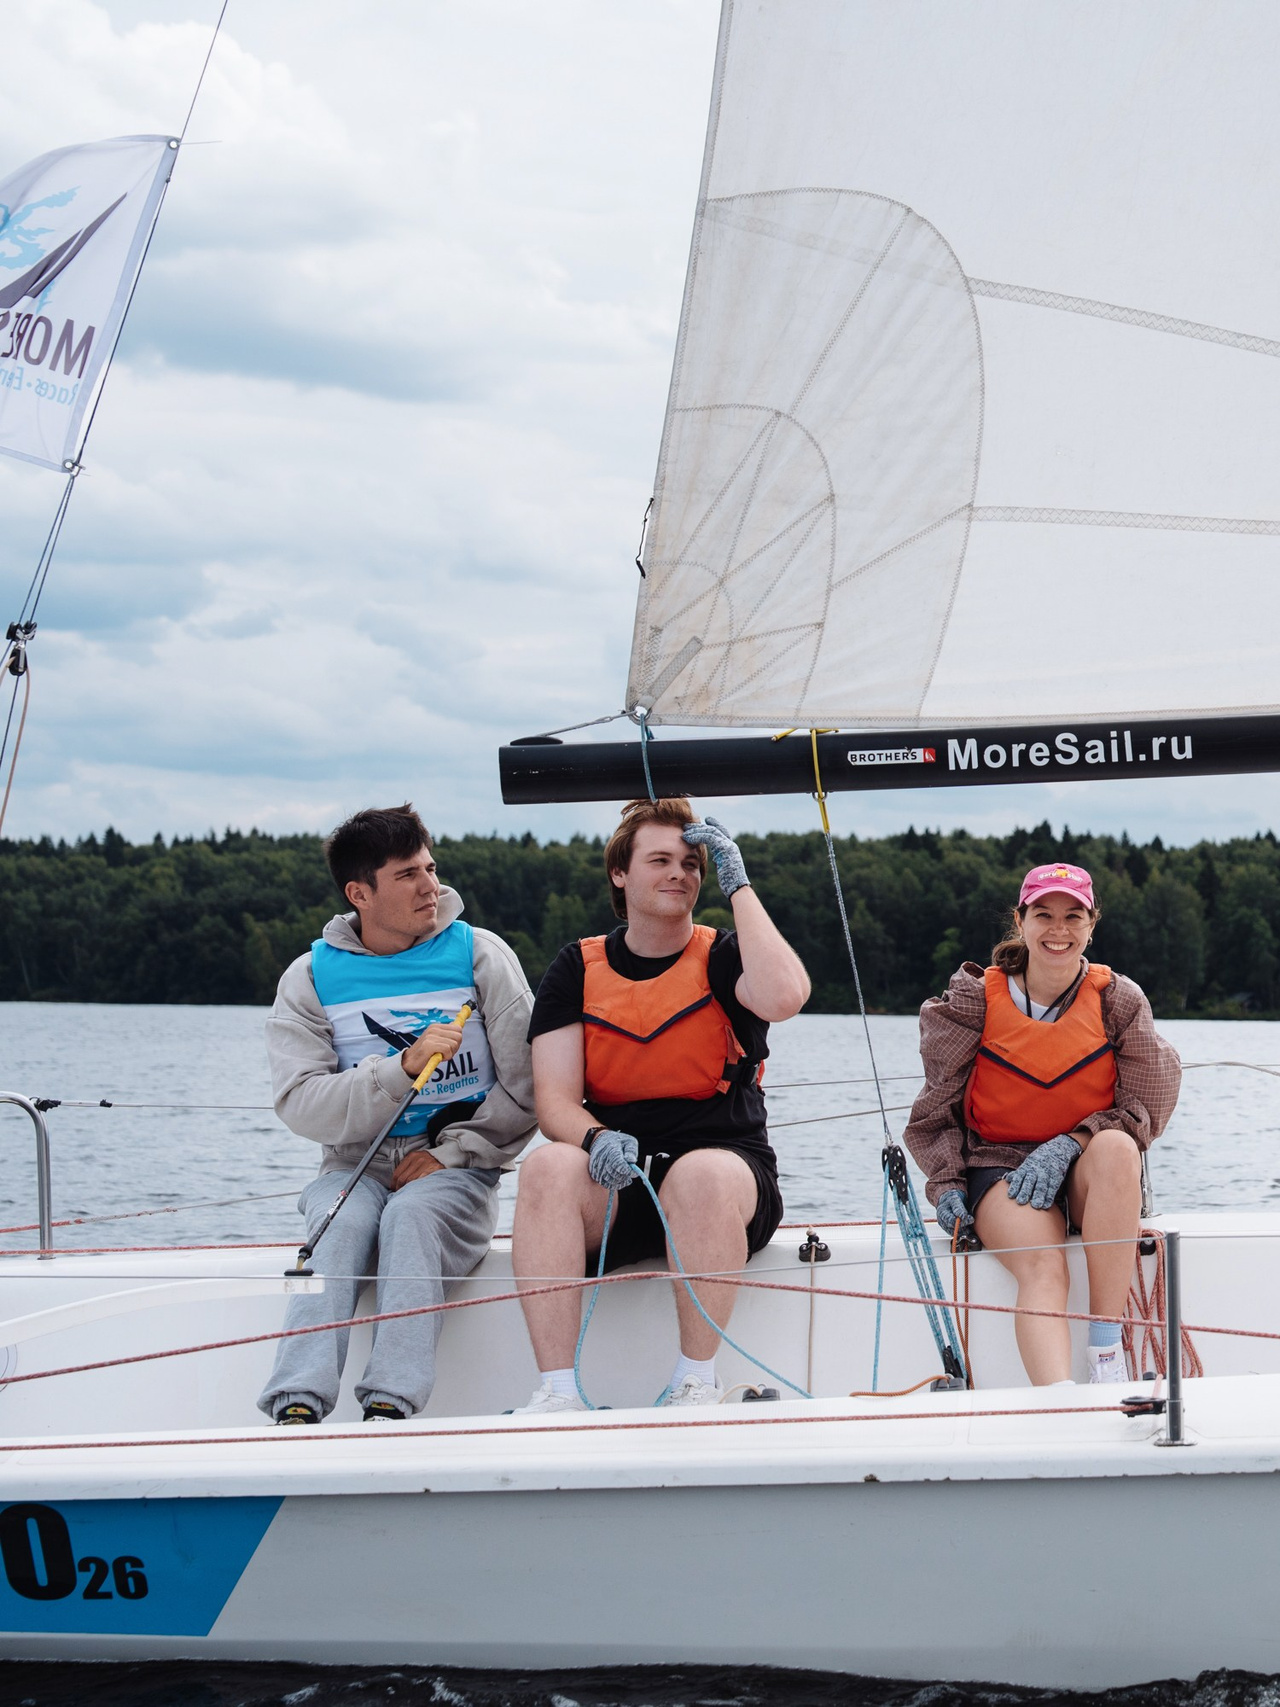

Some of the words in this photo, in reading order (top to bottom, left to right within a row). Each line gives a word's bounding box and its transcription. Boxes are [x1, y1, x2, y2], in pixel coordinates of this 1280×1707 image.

[850, 751, 918, 763] BROTHERS
[947, 730, 1193, 771] MoreSail.ru
[436, 1075, 480, 1095] Regattas
